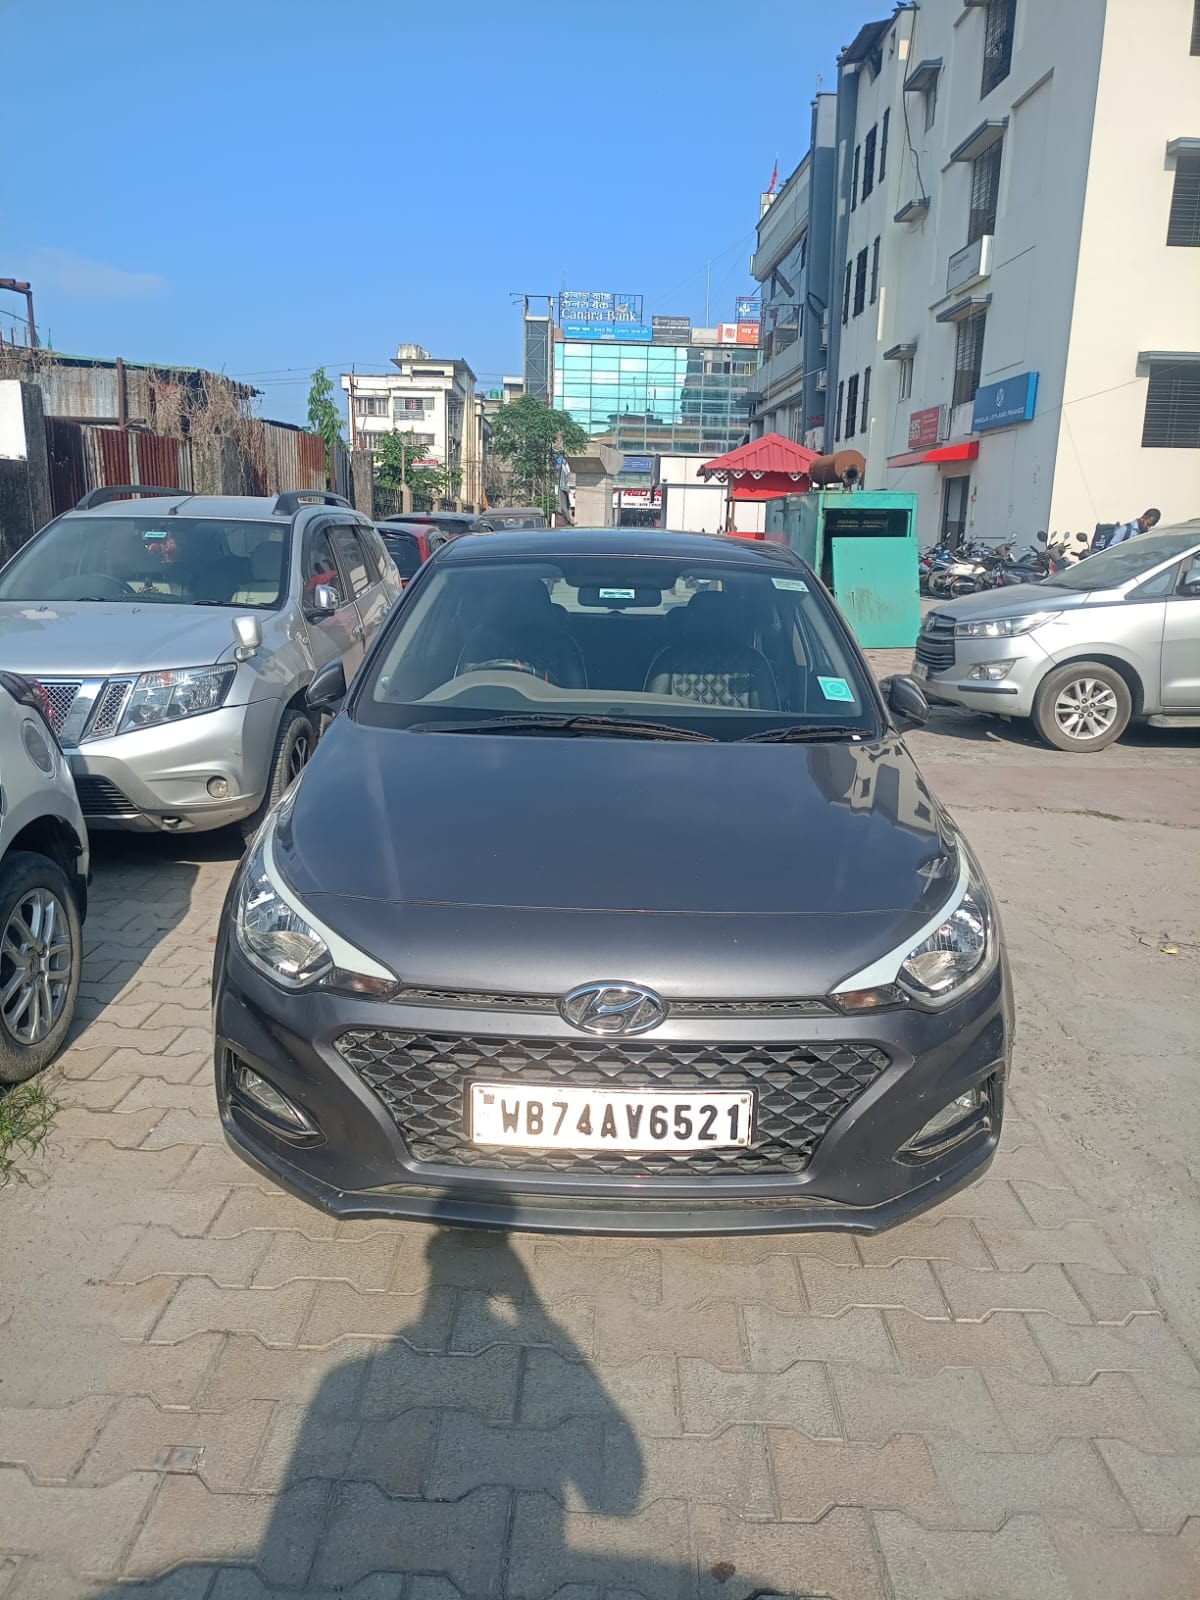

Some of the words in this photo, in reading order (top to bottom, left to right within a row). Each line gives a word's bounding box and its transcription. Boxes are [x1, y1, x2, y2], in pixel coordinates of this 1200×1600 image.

[561, 309, 603, 321] Canara
[607, 310, 636, 323] Bank
[500, 1099, 740, 1141] WB74AV6521
